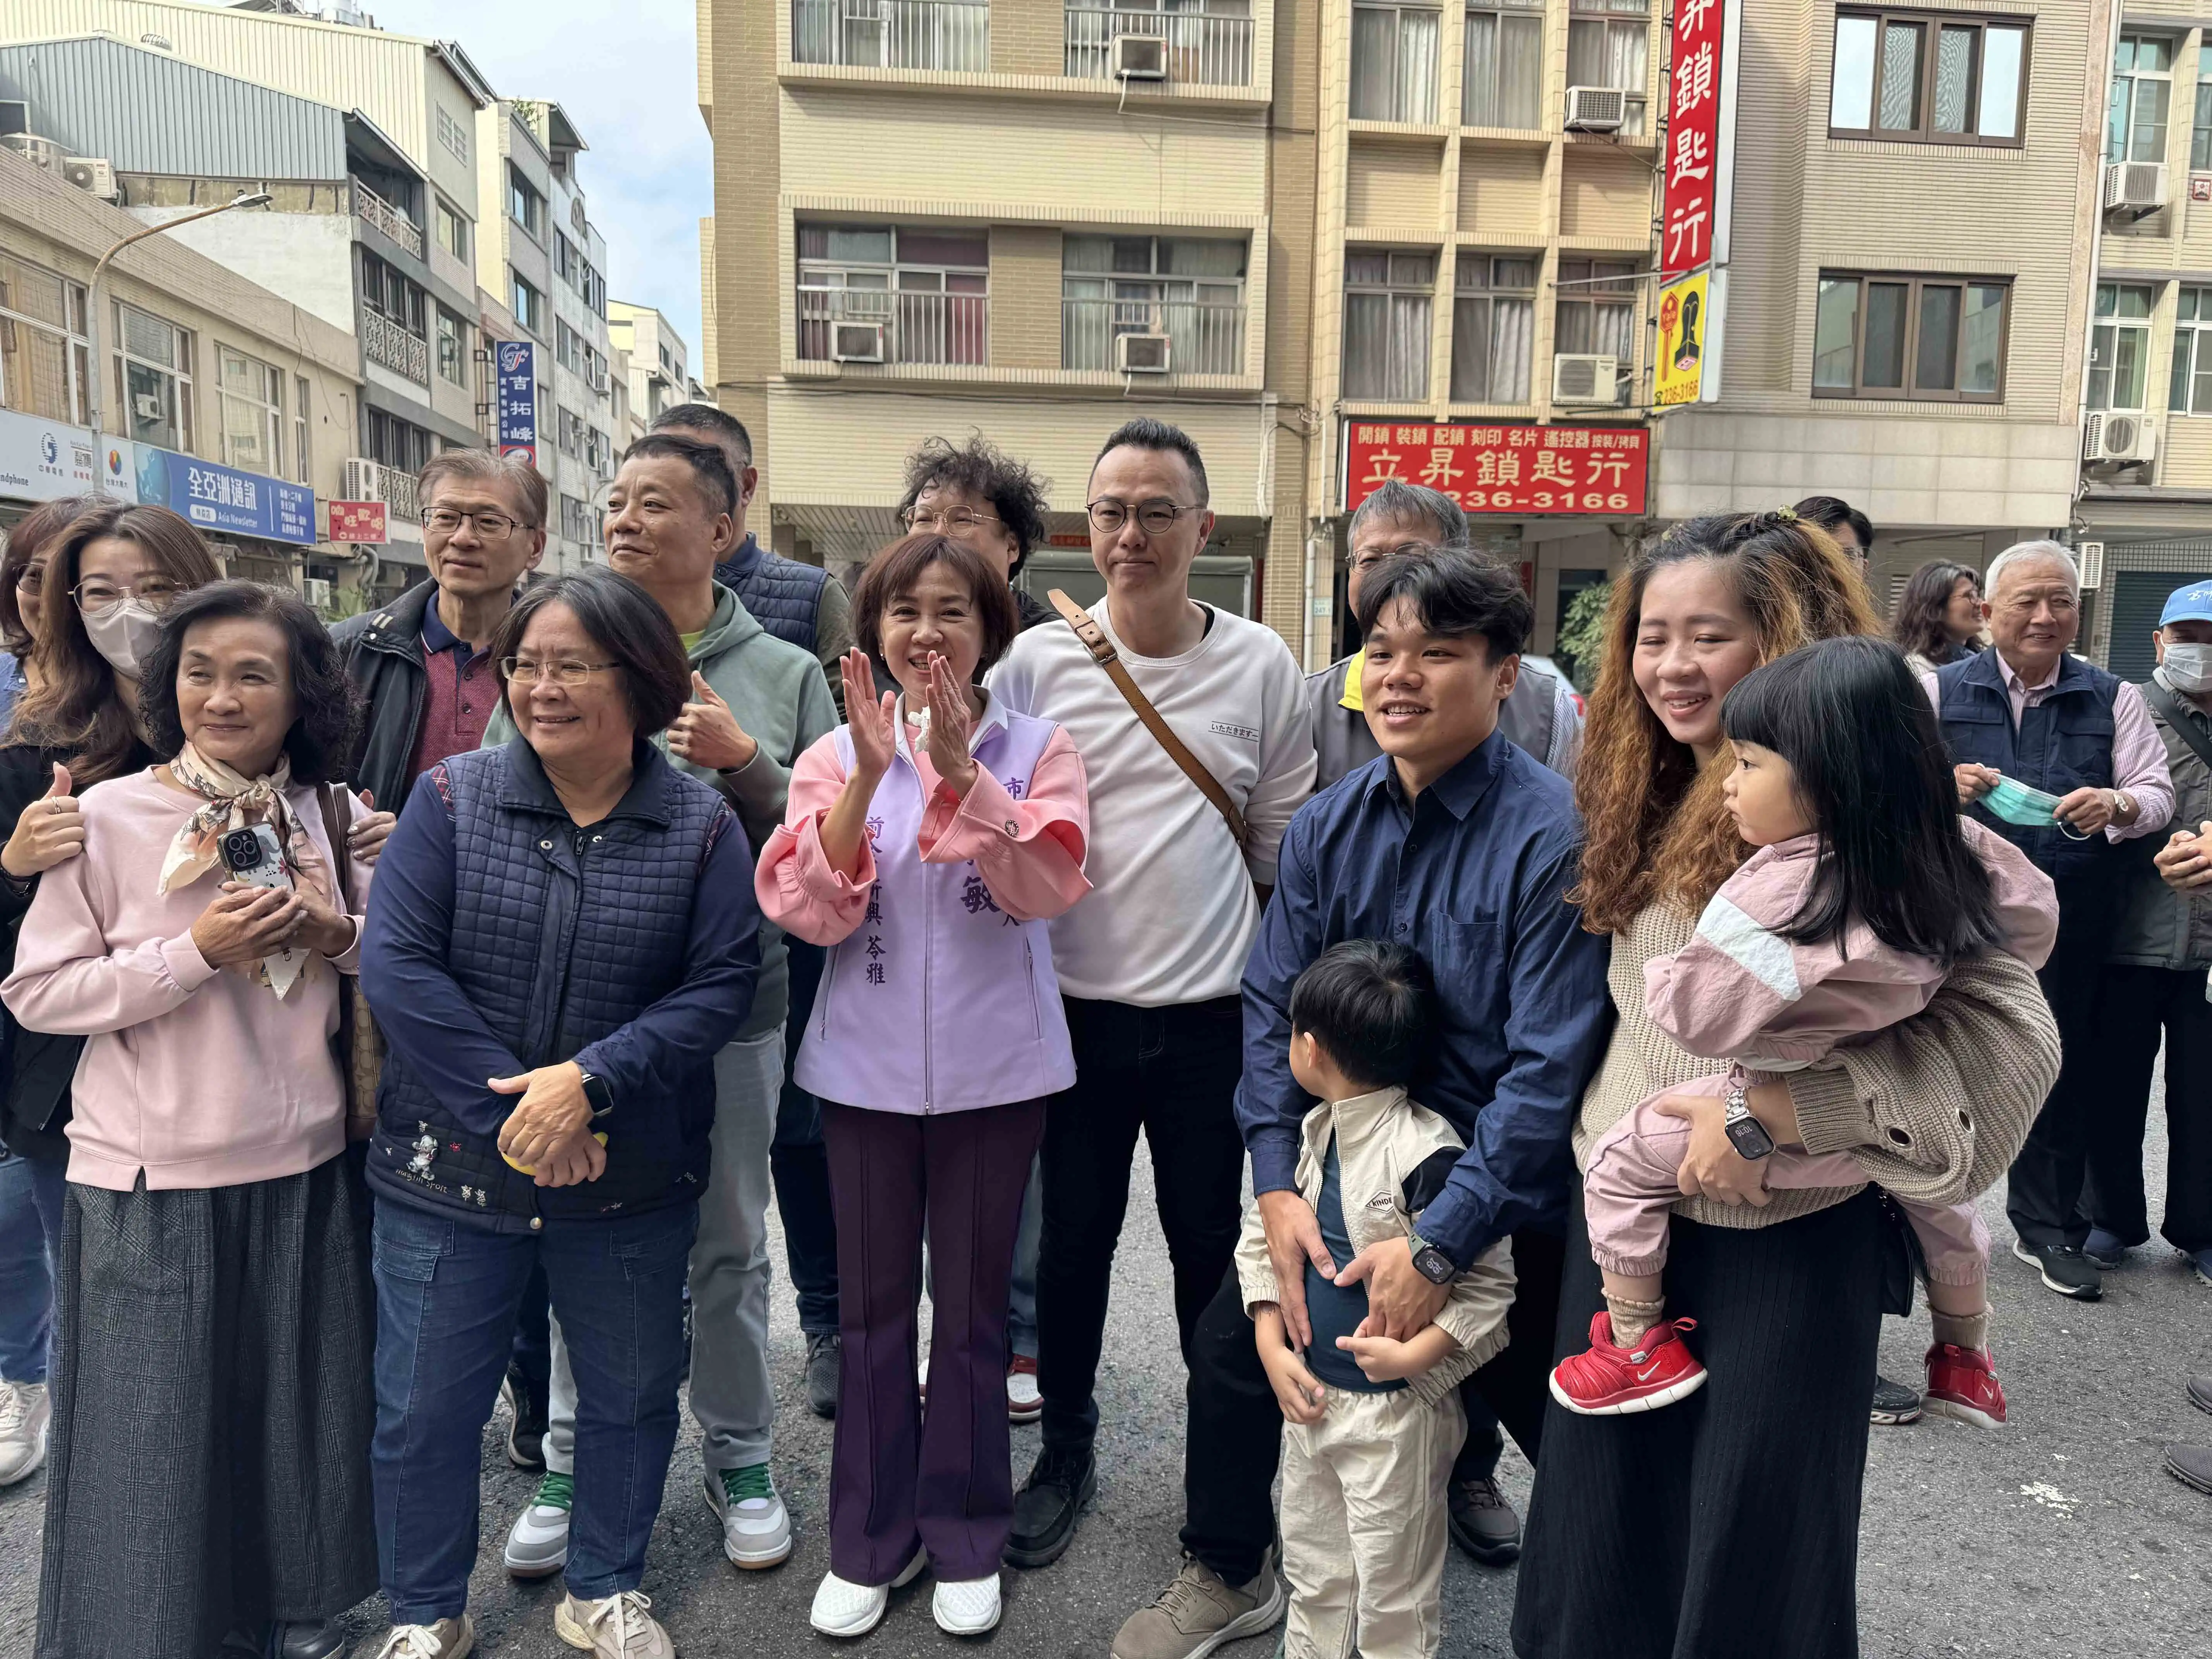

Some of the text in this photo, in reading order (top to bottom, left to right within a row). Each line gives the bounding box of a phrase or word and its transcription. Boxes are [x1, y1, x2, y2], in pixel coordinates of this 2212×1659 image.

[509, 375, 533, 442] 吉拓峰
[1358, 426, 1389, 445] 開鎖
[1433, 427, 1465, 446] 配鎖
[1471, 428, 1502, 447] 刻印
[1508, 429, 1538, 448] 名片
[188, 467, 257, 510] 全亞洲通訊
[1361, 448, 1631, 488] 立昇鎖匙行
[218, 512, 230, 523] Asia
[866, 935, 886, 986] 苓雅
